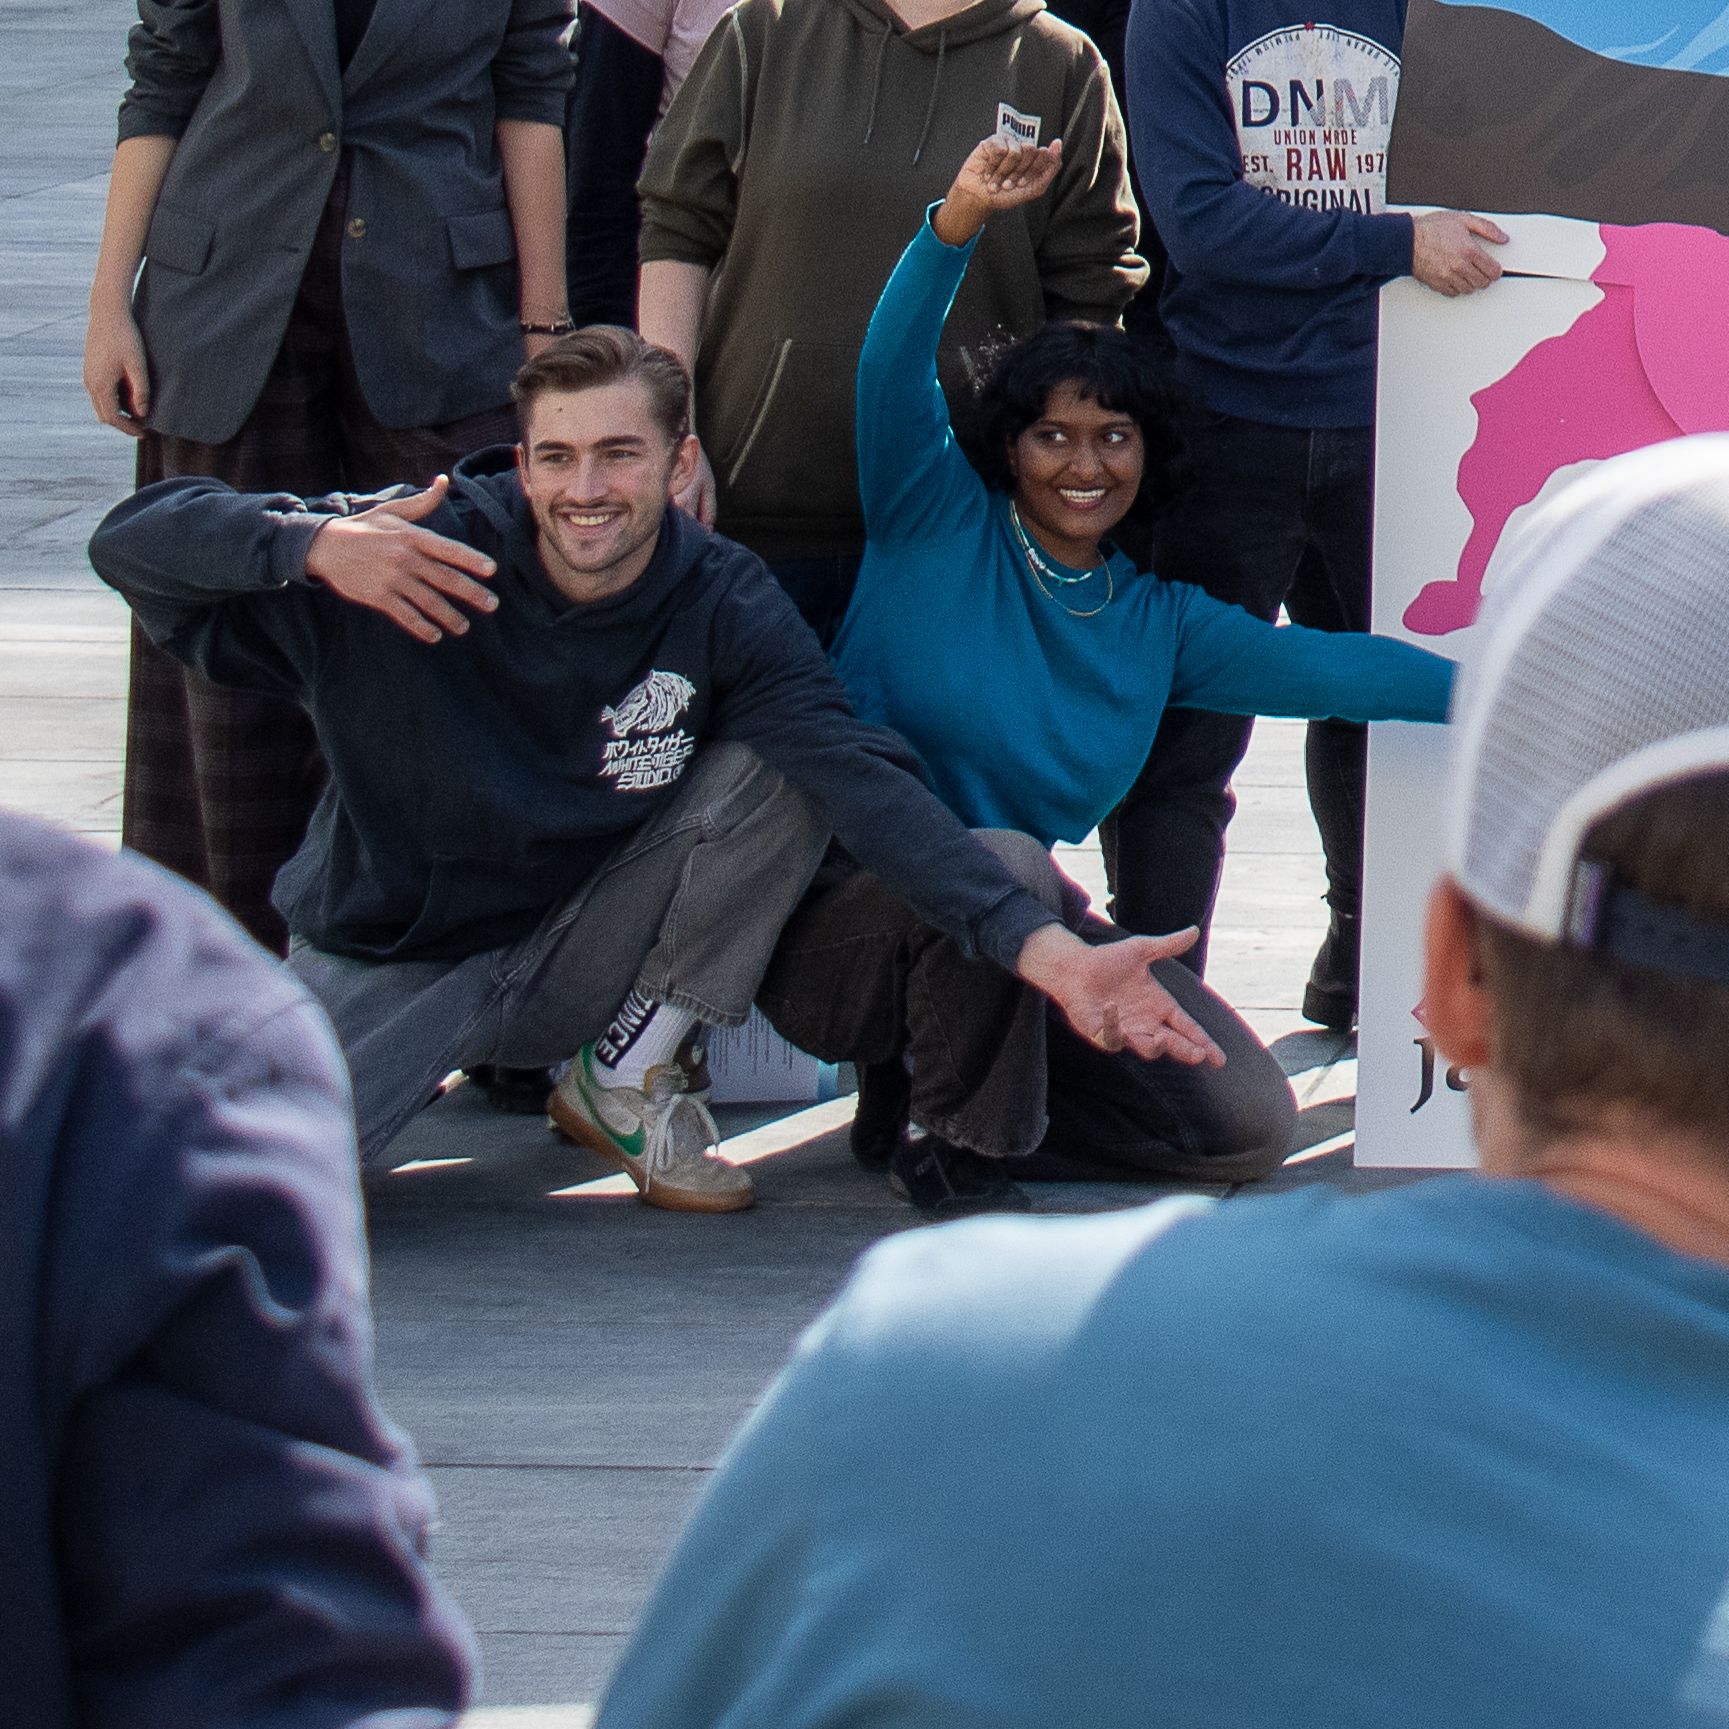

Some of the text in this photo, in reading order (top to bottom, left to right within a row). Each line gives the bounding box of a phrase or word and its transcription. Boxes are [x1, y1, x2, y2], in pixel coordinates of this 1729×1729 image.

[1242, 76, 1389, 129] DNM
[1002, 112, 1036, 139] PUMA
[1273, 129, 1316, 146] UNION
[1243, 154, 1274, 174] EST.
[1286, 147, 1347, 182] RAW
